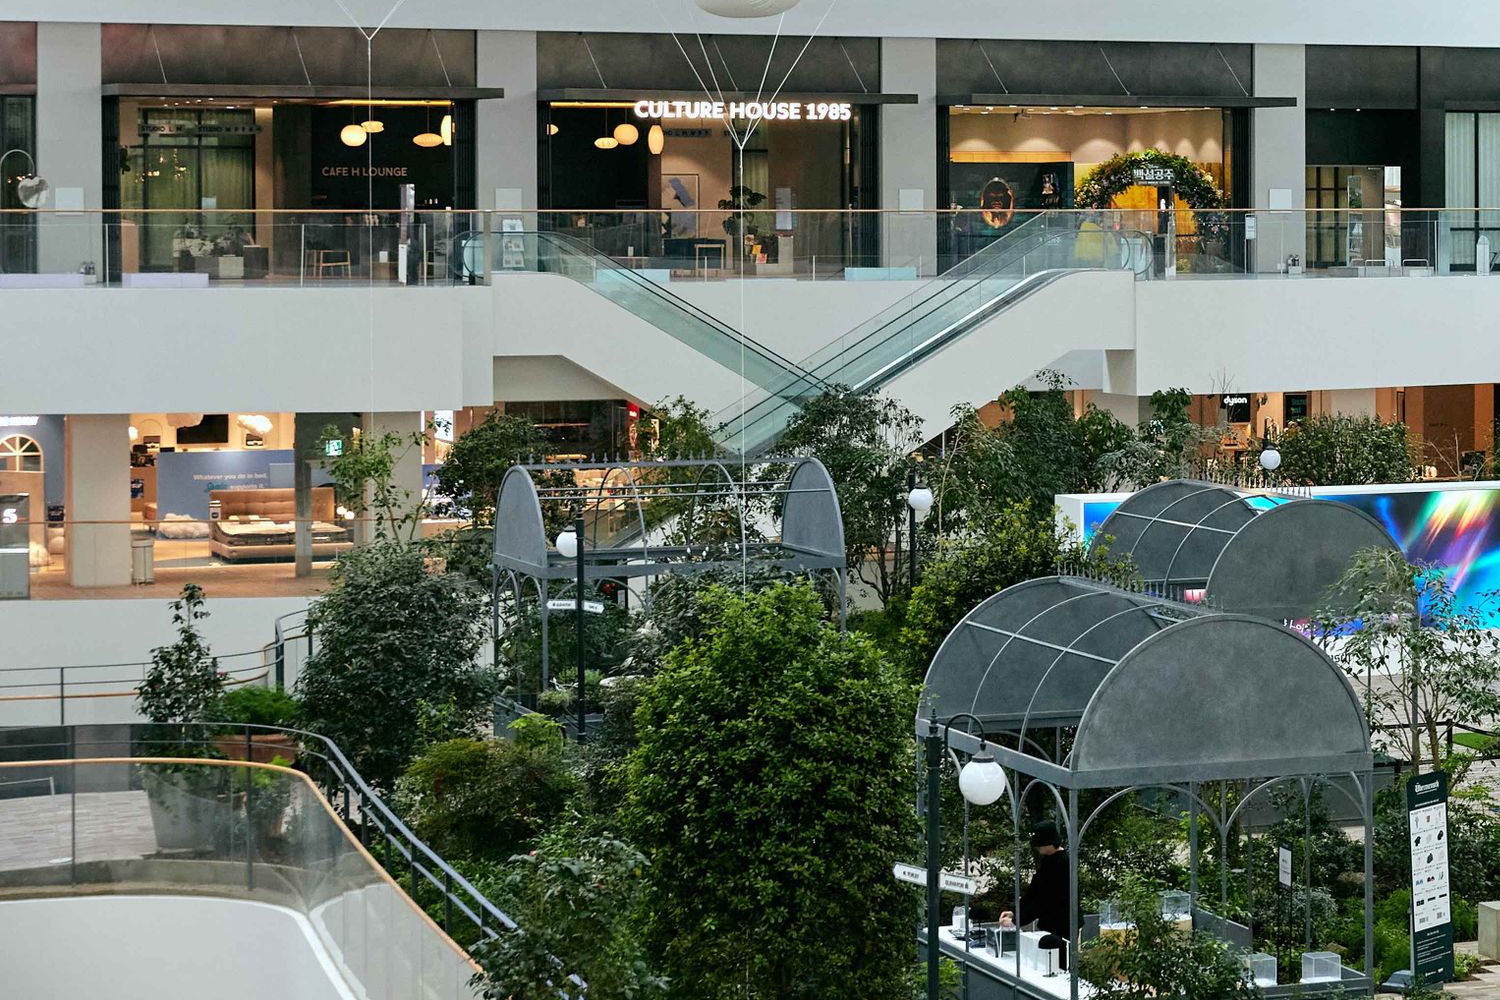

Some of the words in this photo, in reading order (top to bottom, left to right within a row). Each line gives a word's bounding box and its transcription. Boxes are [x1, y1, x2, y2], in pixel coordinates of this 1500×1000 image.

[634, 100, 724, 119] CULTURE
[730, 102, 801, 119] HOUSE
[806, 103, 851, 120] 1985
[322, 166, 349, 177] CAFE
[351, 167, 360, 177] H
[362, 166, 408, 177] LOUNGE
[1223, 395, 1247, 406] dyson
